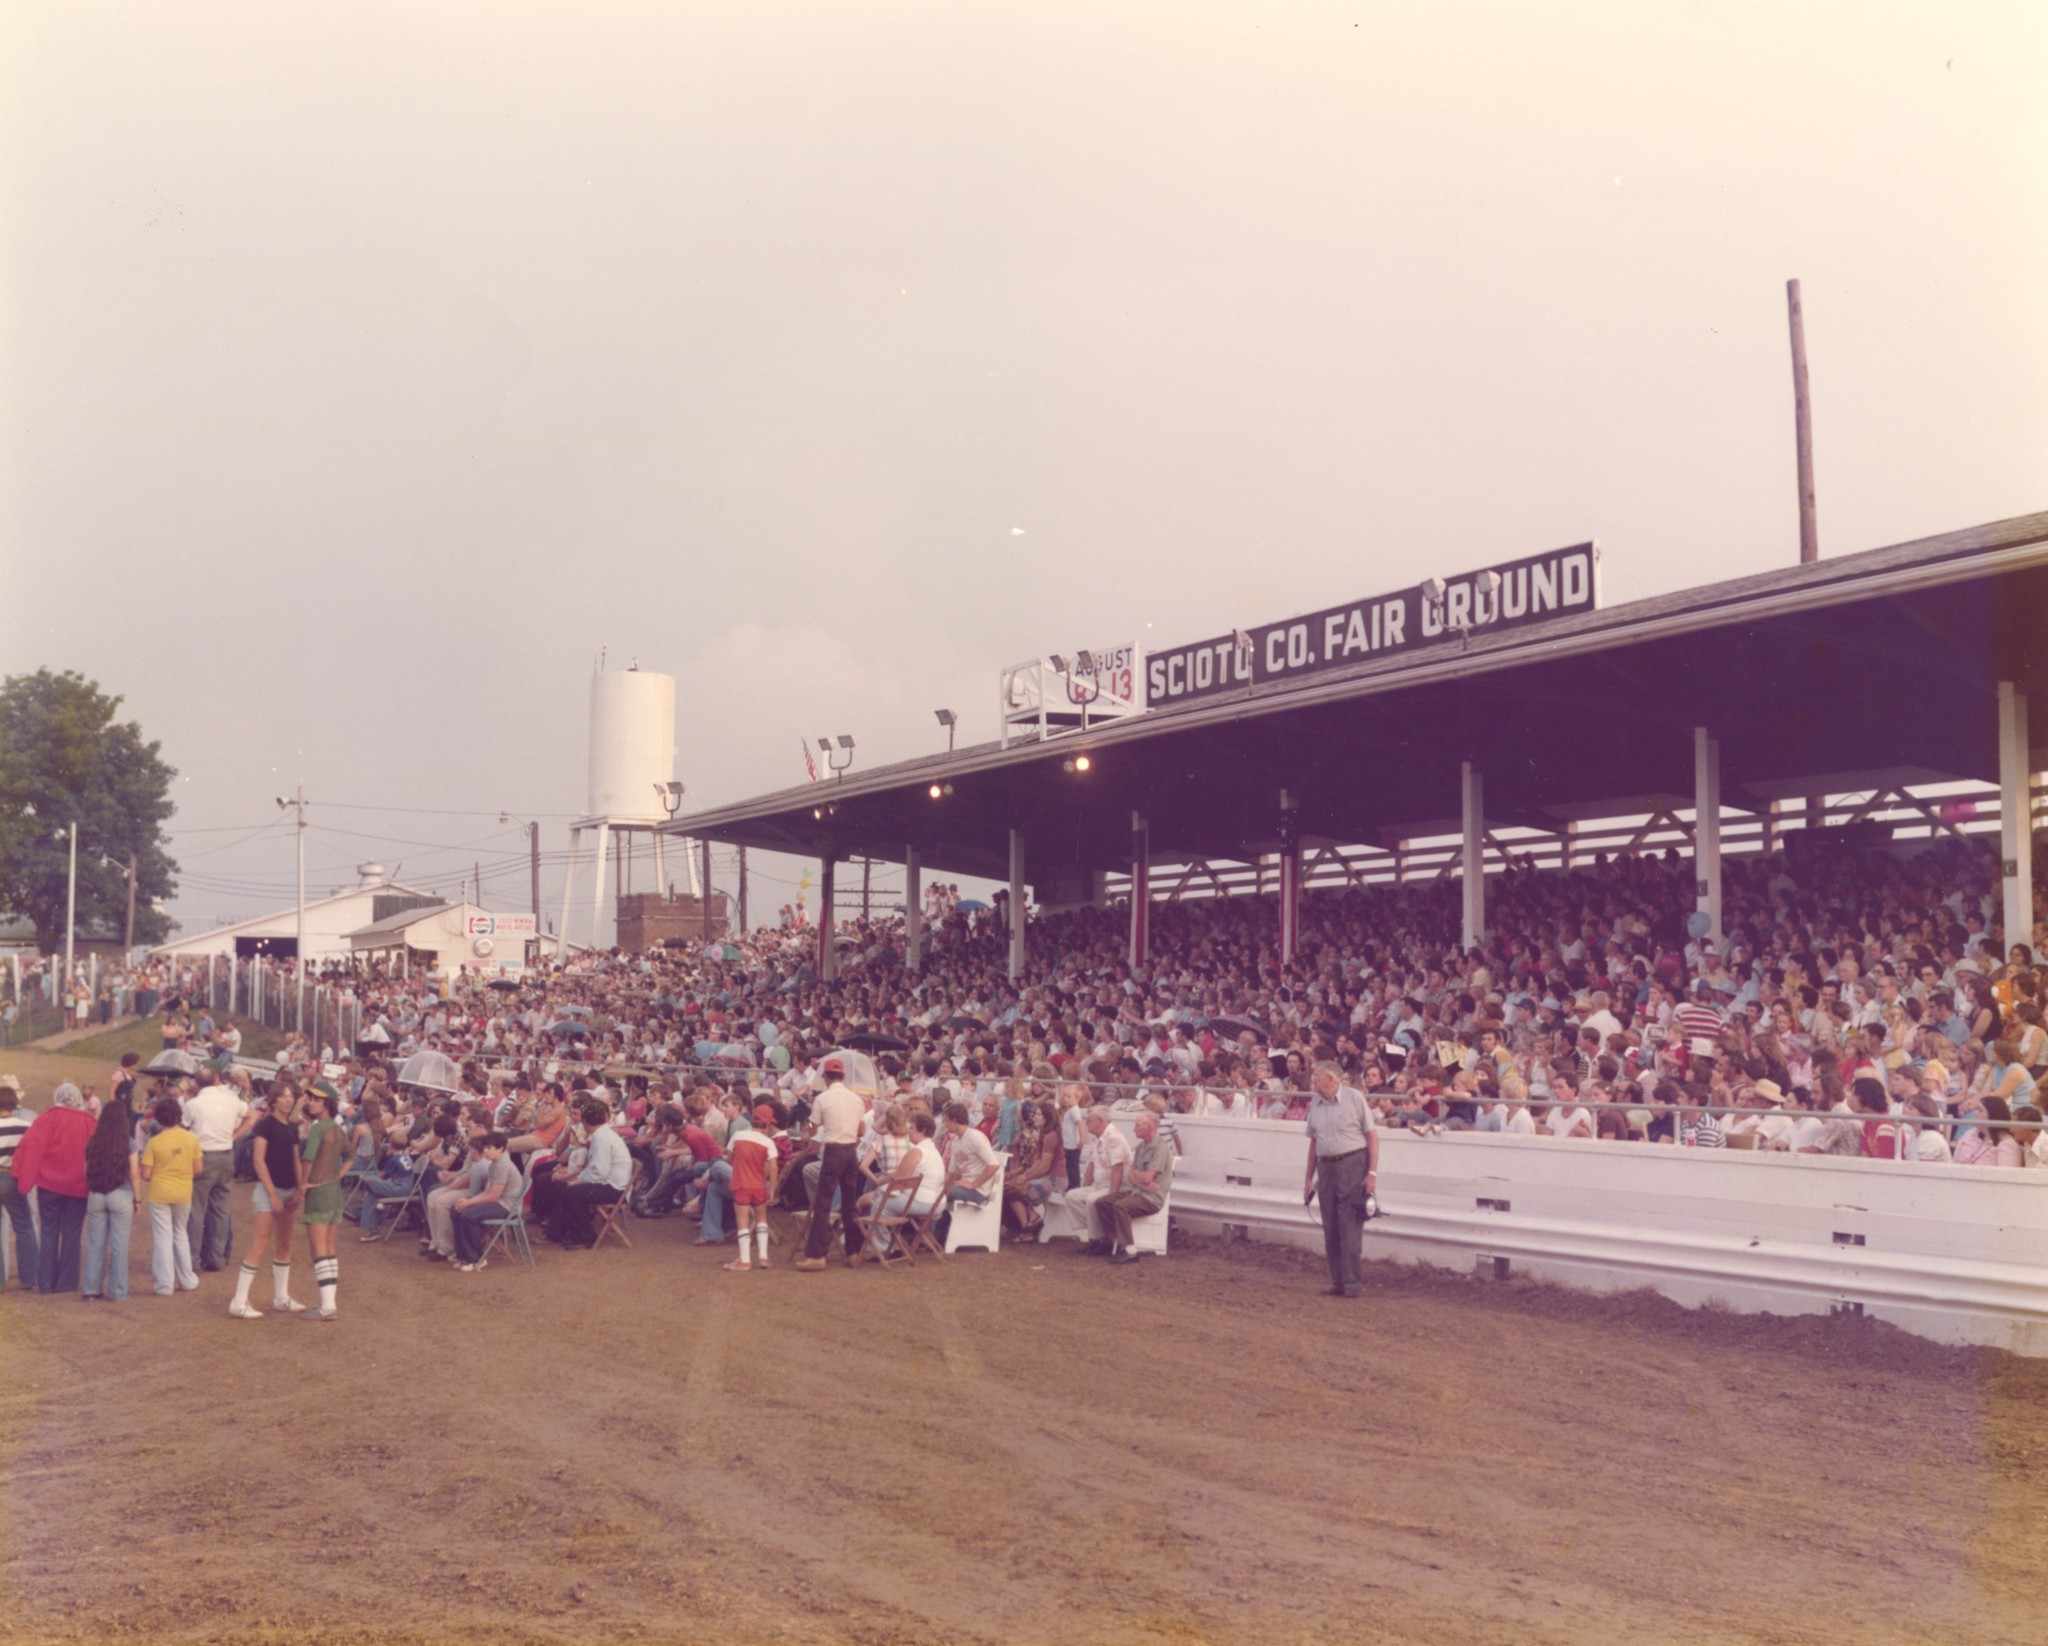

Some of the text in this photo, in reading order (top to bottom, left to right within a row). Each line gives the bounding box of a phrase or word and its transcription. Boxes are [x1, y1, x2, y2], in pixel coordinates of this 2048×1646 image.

[1150, 553, 1589, 699] SCIOTO CO. FAIR GROUND
